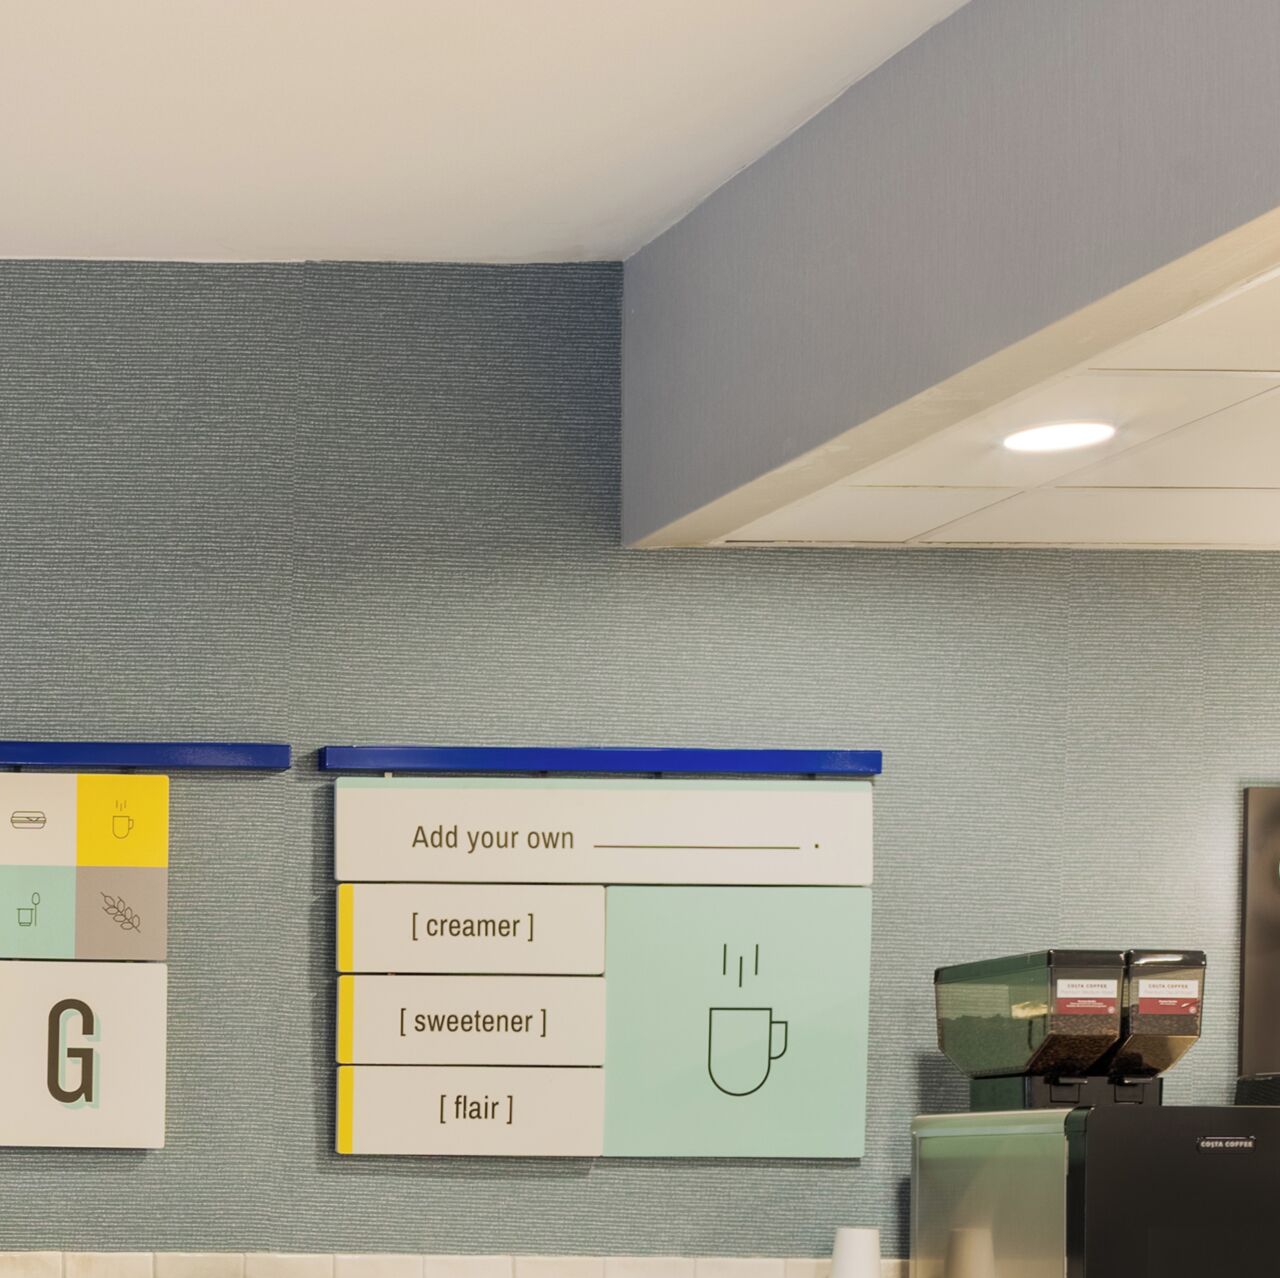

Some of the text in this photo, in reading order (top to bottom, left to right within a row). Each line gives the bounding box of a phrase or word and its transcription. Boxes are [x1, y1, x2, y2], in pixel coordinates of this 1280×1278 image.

[411, 824, 574, 854] Add your own
[426, 918, 520, 937] creamer
[414, 1010, 533, 1033] sweetener
[47, 998, 97, 1106] G
[454, 1094, 500, 1120] flair
[1200, 1140, 1254, 1148] COSTA COFFEE
